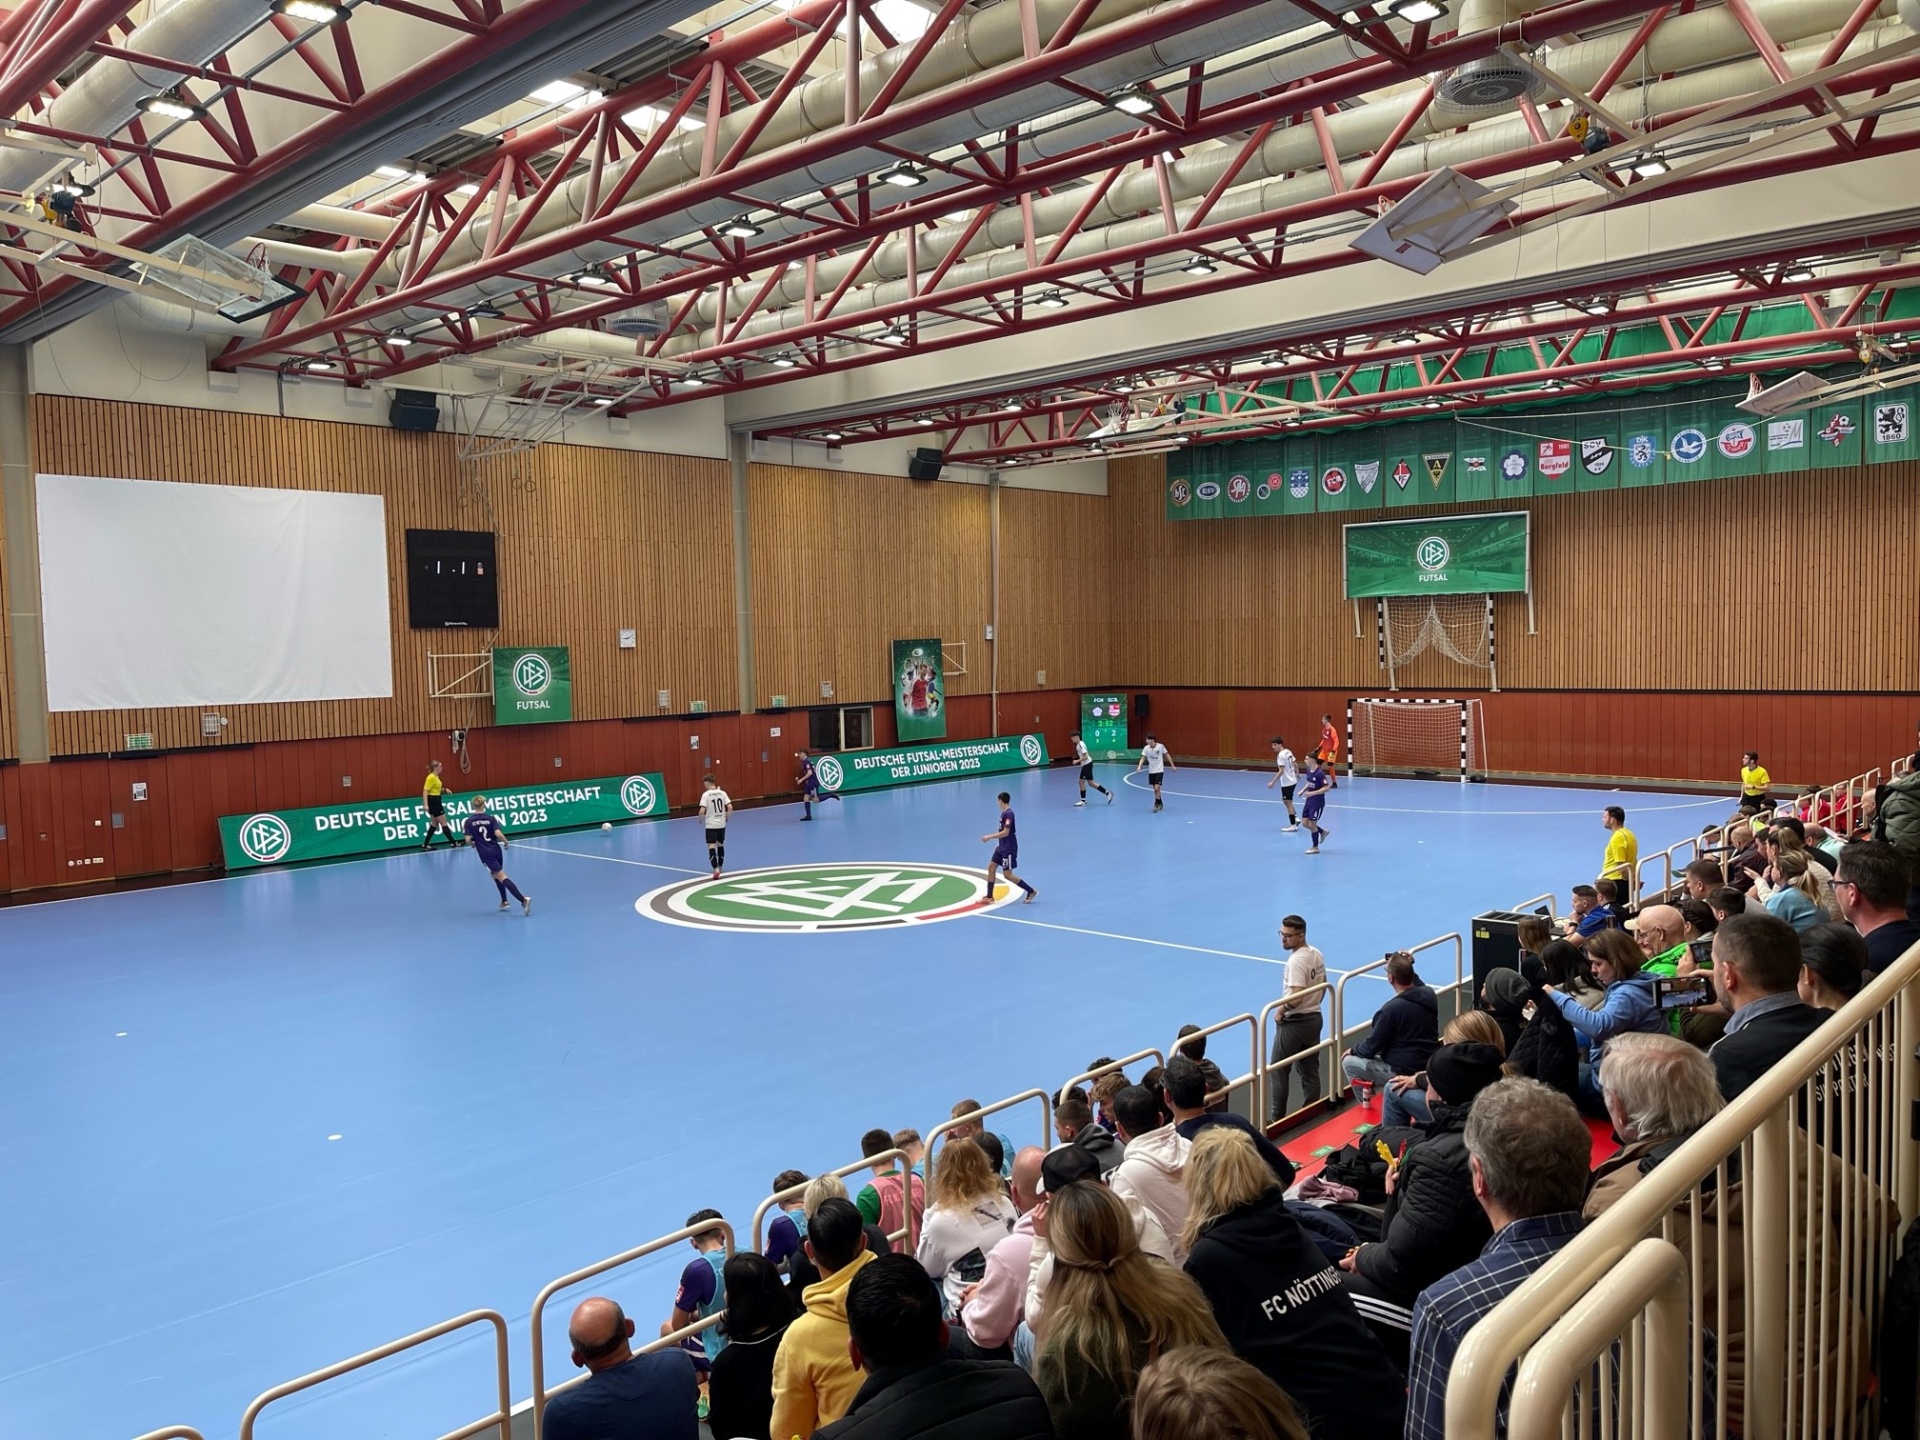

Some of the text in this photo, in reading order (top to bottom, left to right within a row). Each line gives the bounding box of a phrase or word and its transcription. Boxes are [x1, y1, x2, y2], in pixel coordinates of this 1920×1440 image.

[1418, 573, 1448, 582] FUTSAL
[516, 700, 551, 710] FUTSAL
[854, 742, 1009, 770] DEUTSCHE FUTSAL-MEISTERSCHAFT
[891, 757, 980, 778] DER JUNIOREN 2023
[315, 786, 600, 831] DEUTSCHE FSALMEISTERSCHAFT
[711, 798, 723, 813] 10
[383, 823, 419, 841] DER
[512, 808, 547, 826] 2023
[479, 826, 491, 842] 2
[1261, 1295, 1287, 1321] FC
